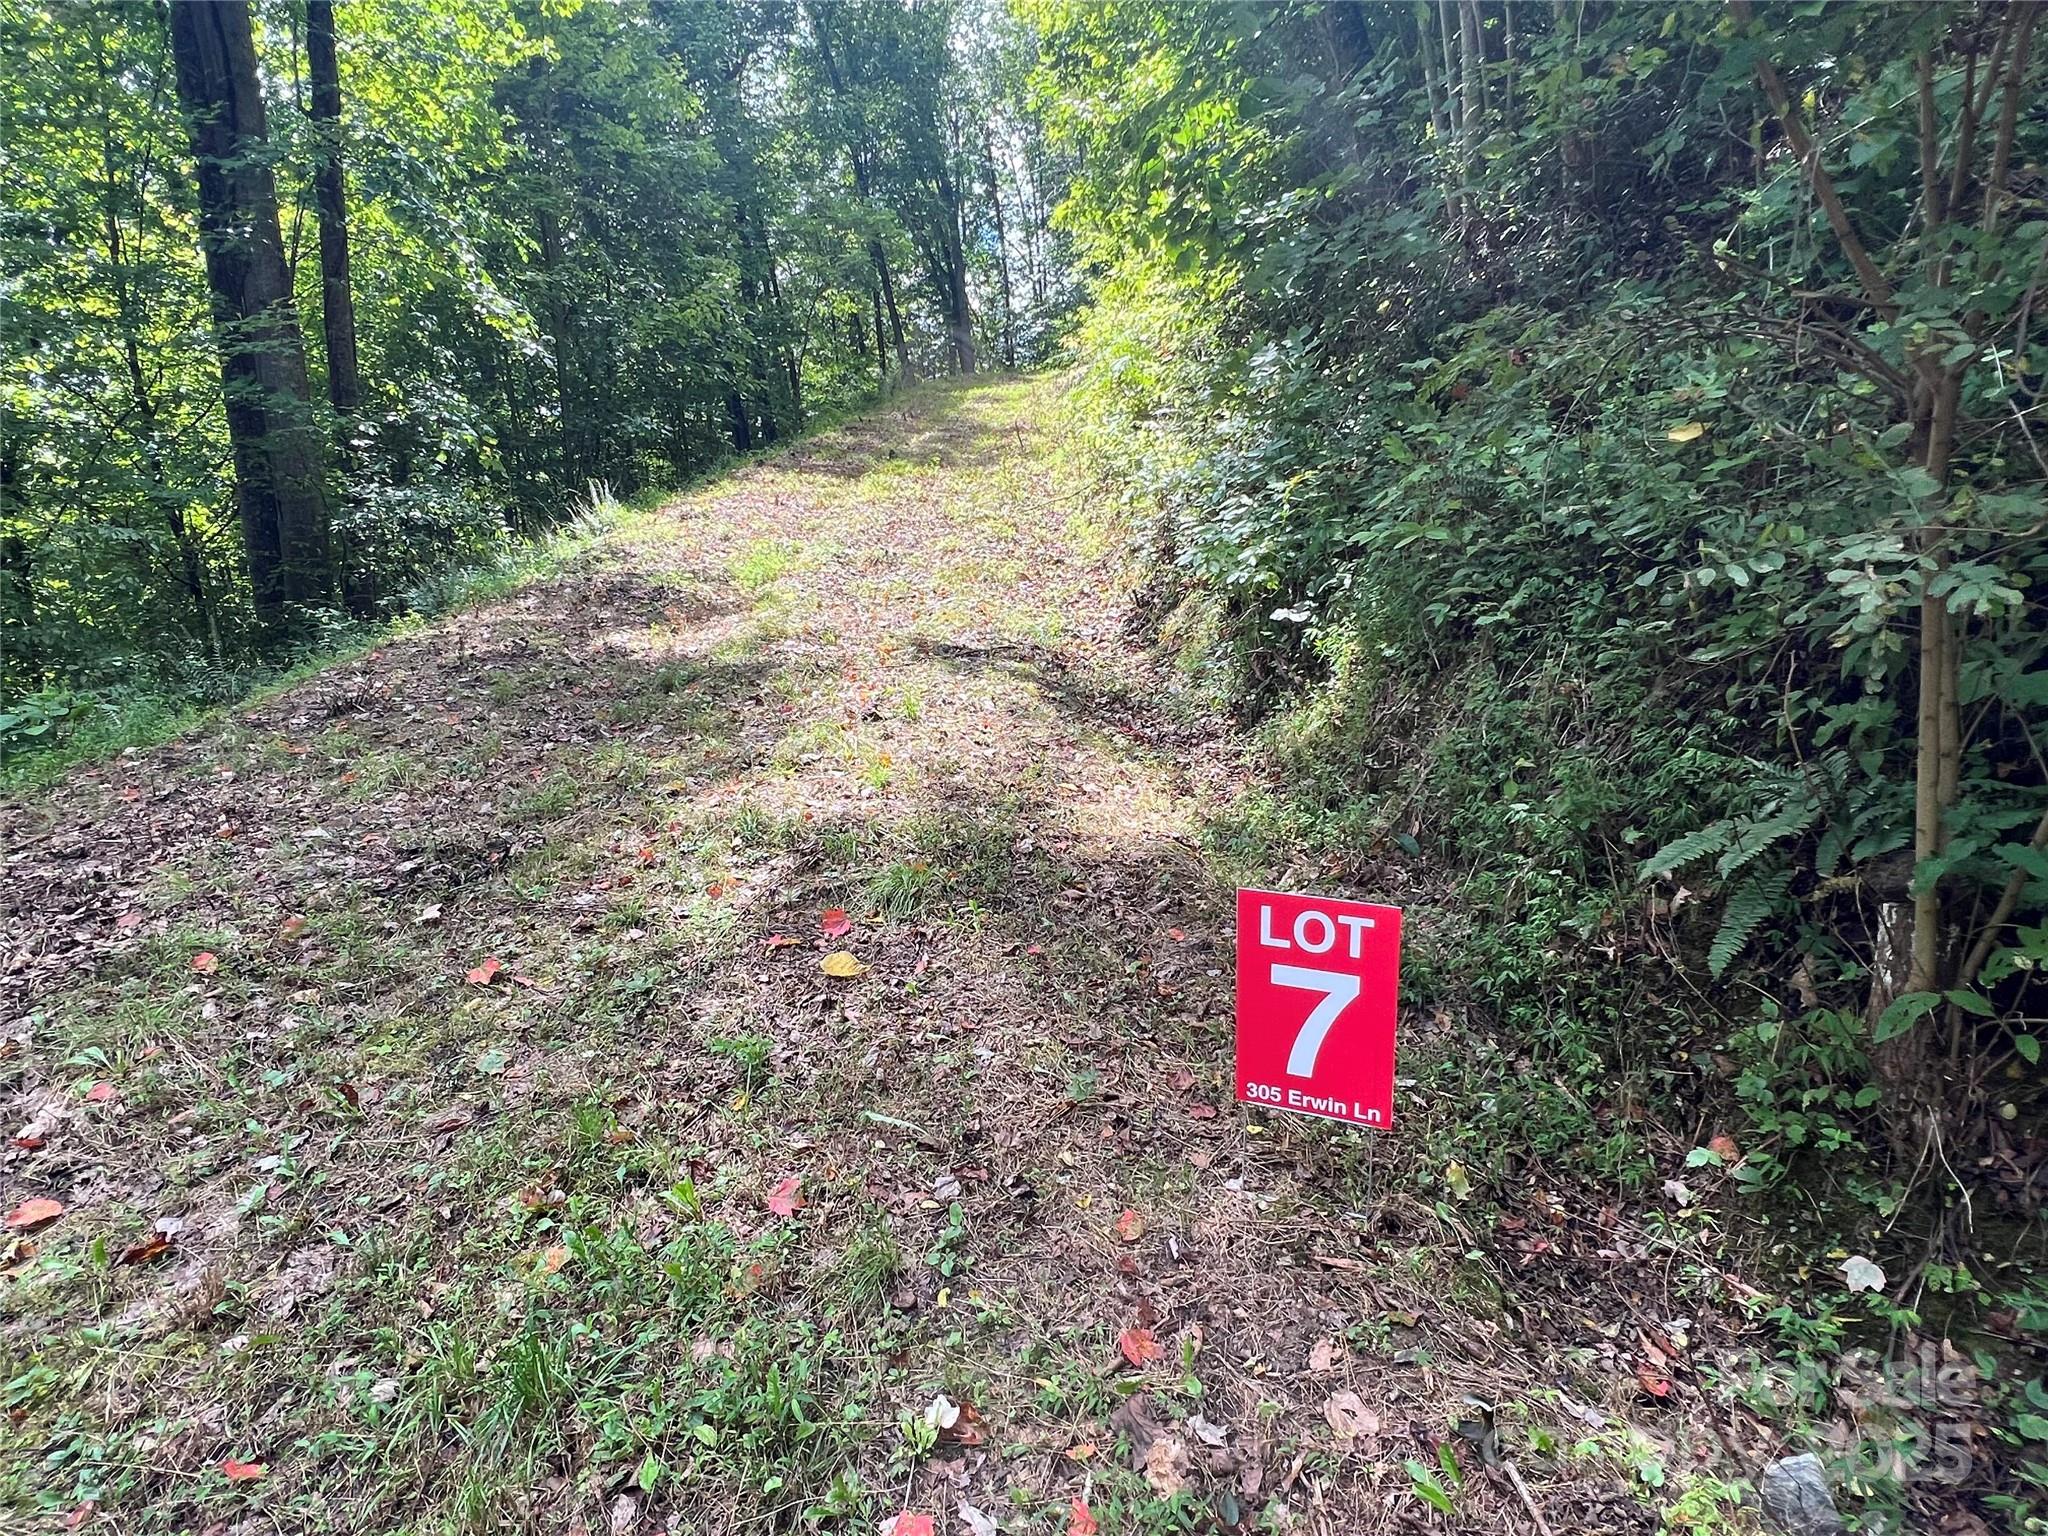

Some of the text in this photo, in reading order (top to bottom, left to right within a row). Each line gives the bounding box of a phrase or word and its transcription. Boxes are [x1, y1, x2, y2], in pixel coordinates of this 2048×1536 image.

[1260, 905, 1375, 959] LOT
[1270, 963, 1361, 1079] 7
[1246, 1082, 1381, 1123] 305 Erwin Ln
